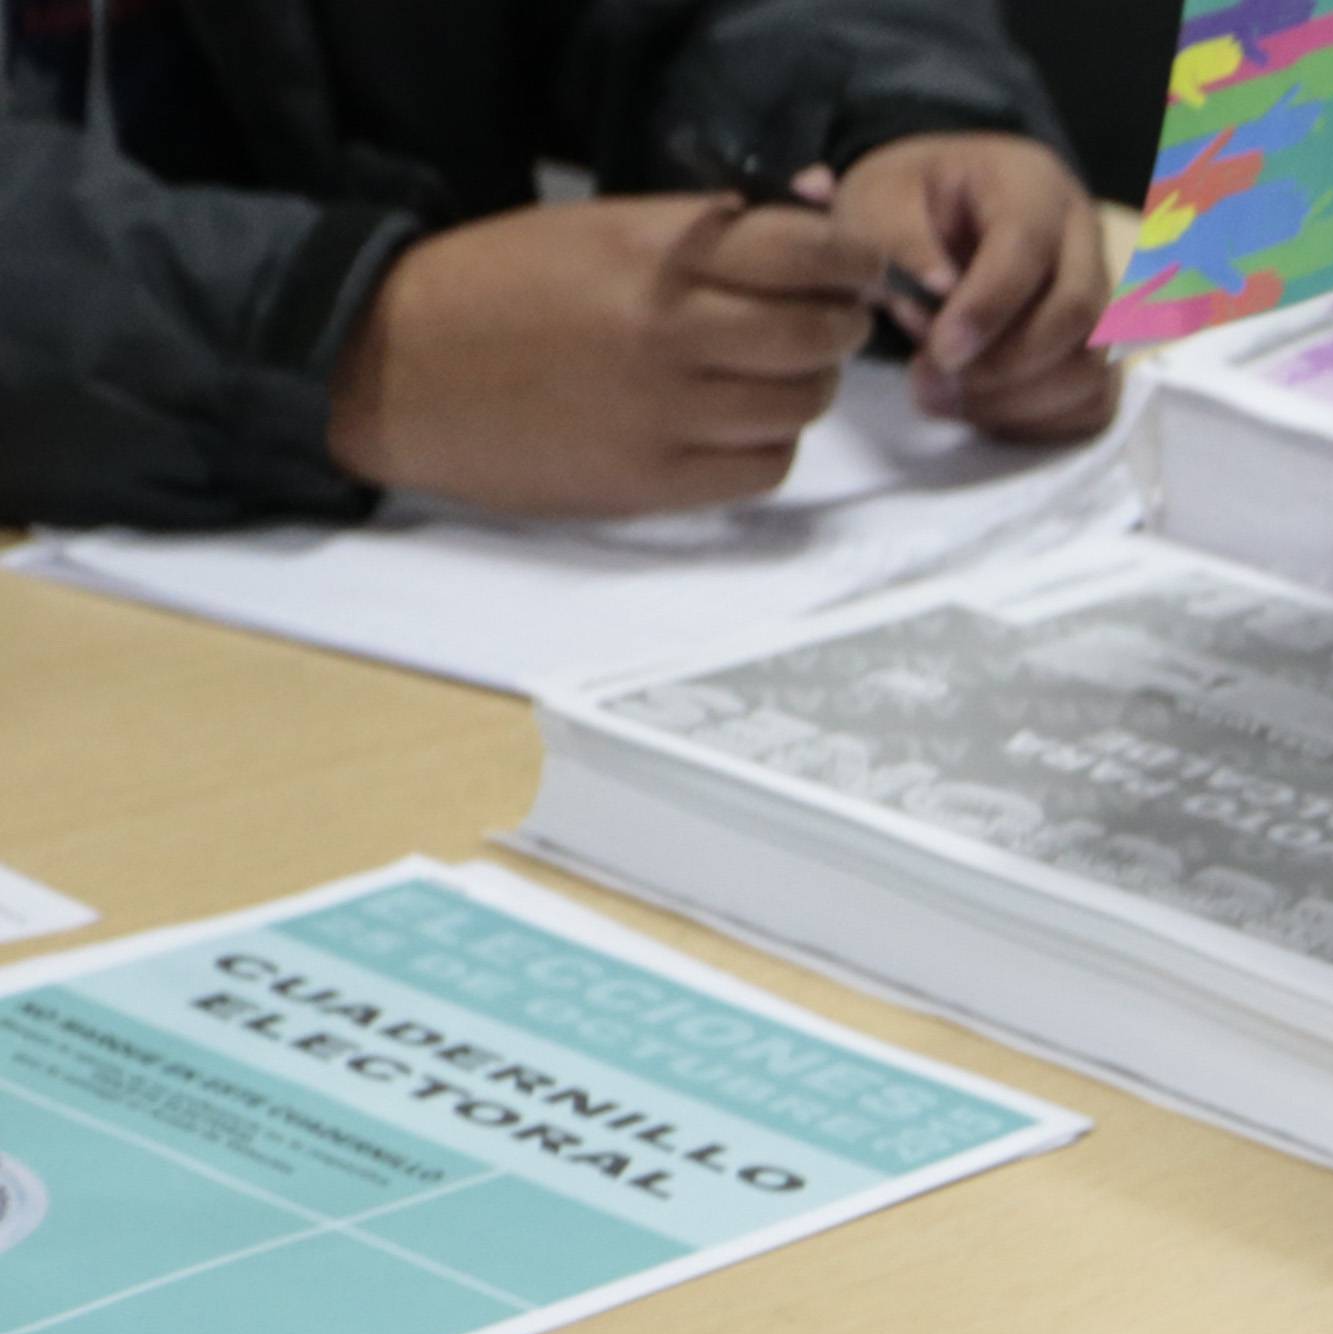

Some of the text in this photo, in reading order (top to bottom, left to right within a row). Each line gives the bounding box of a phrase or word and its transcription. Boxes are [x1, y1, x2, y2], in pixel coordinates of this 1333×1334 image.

[195, 990, 674, 1202] ELECTORAL
[214, 949, 808, 1196] CUADERNILLO
[355, 893, 943, 1117] ELECCIONES
